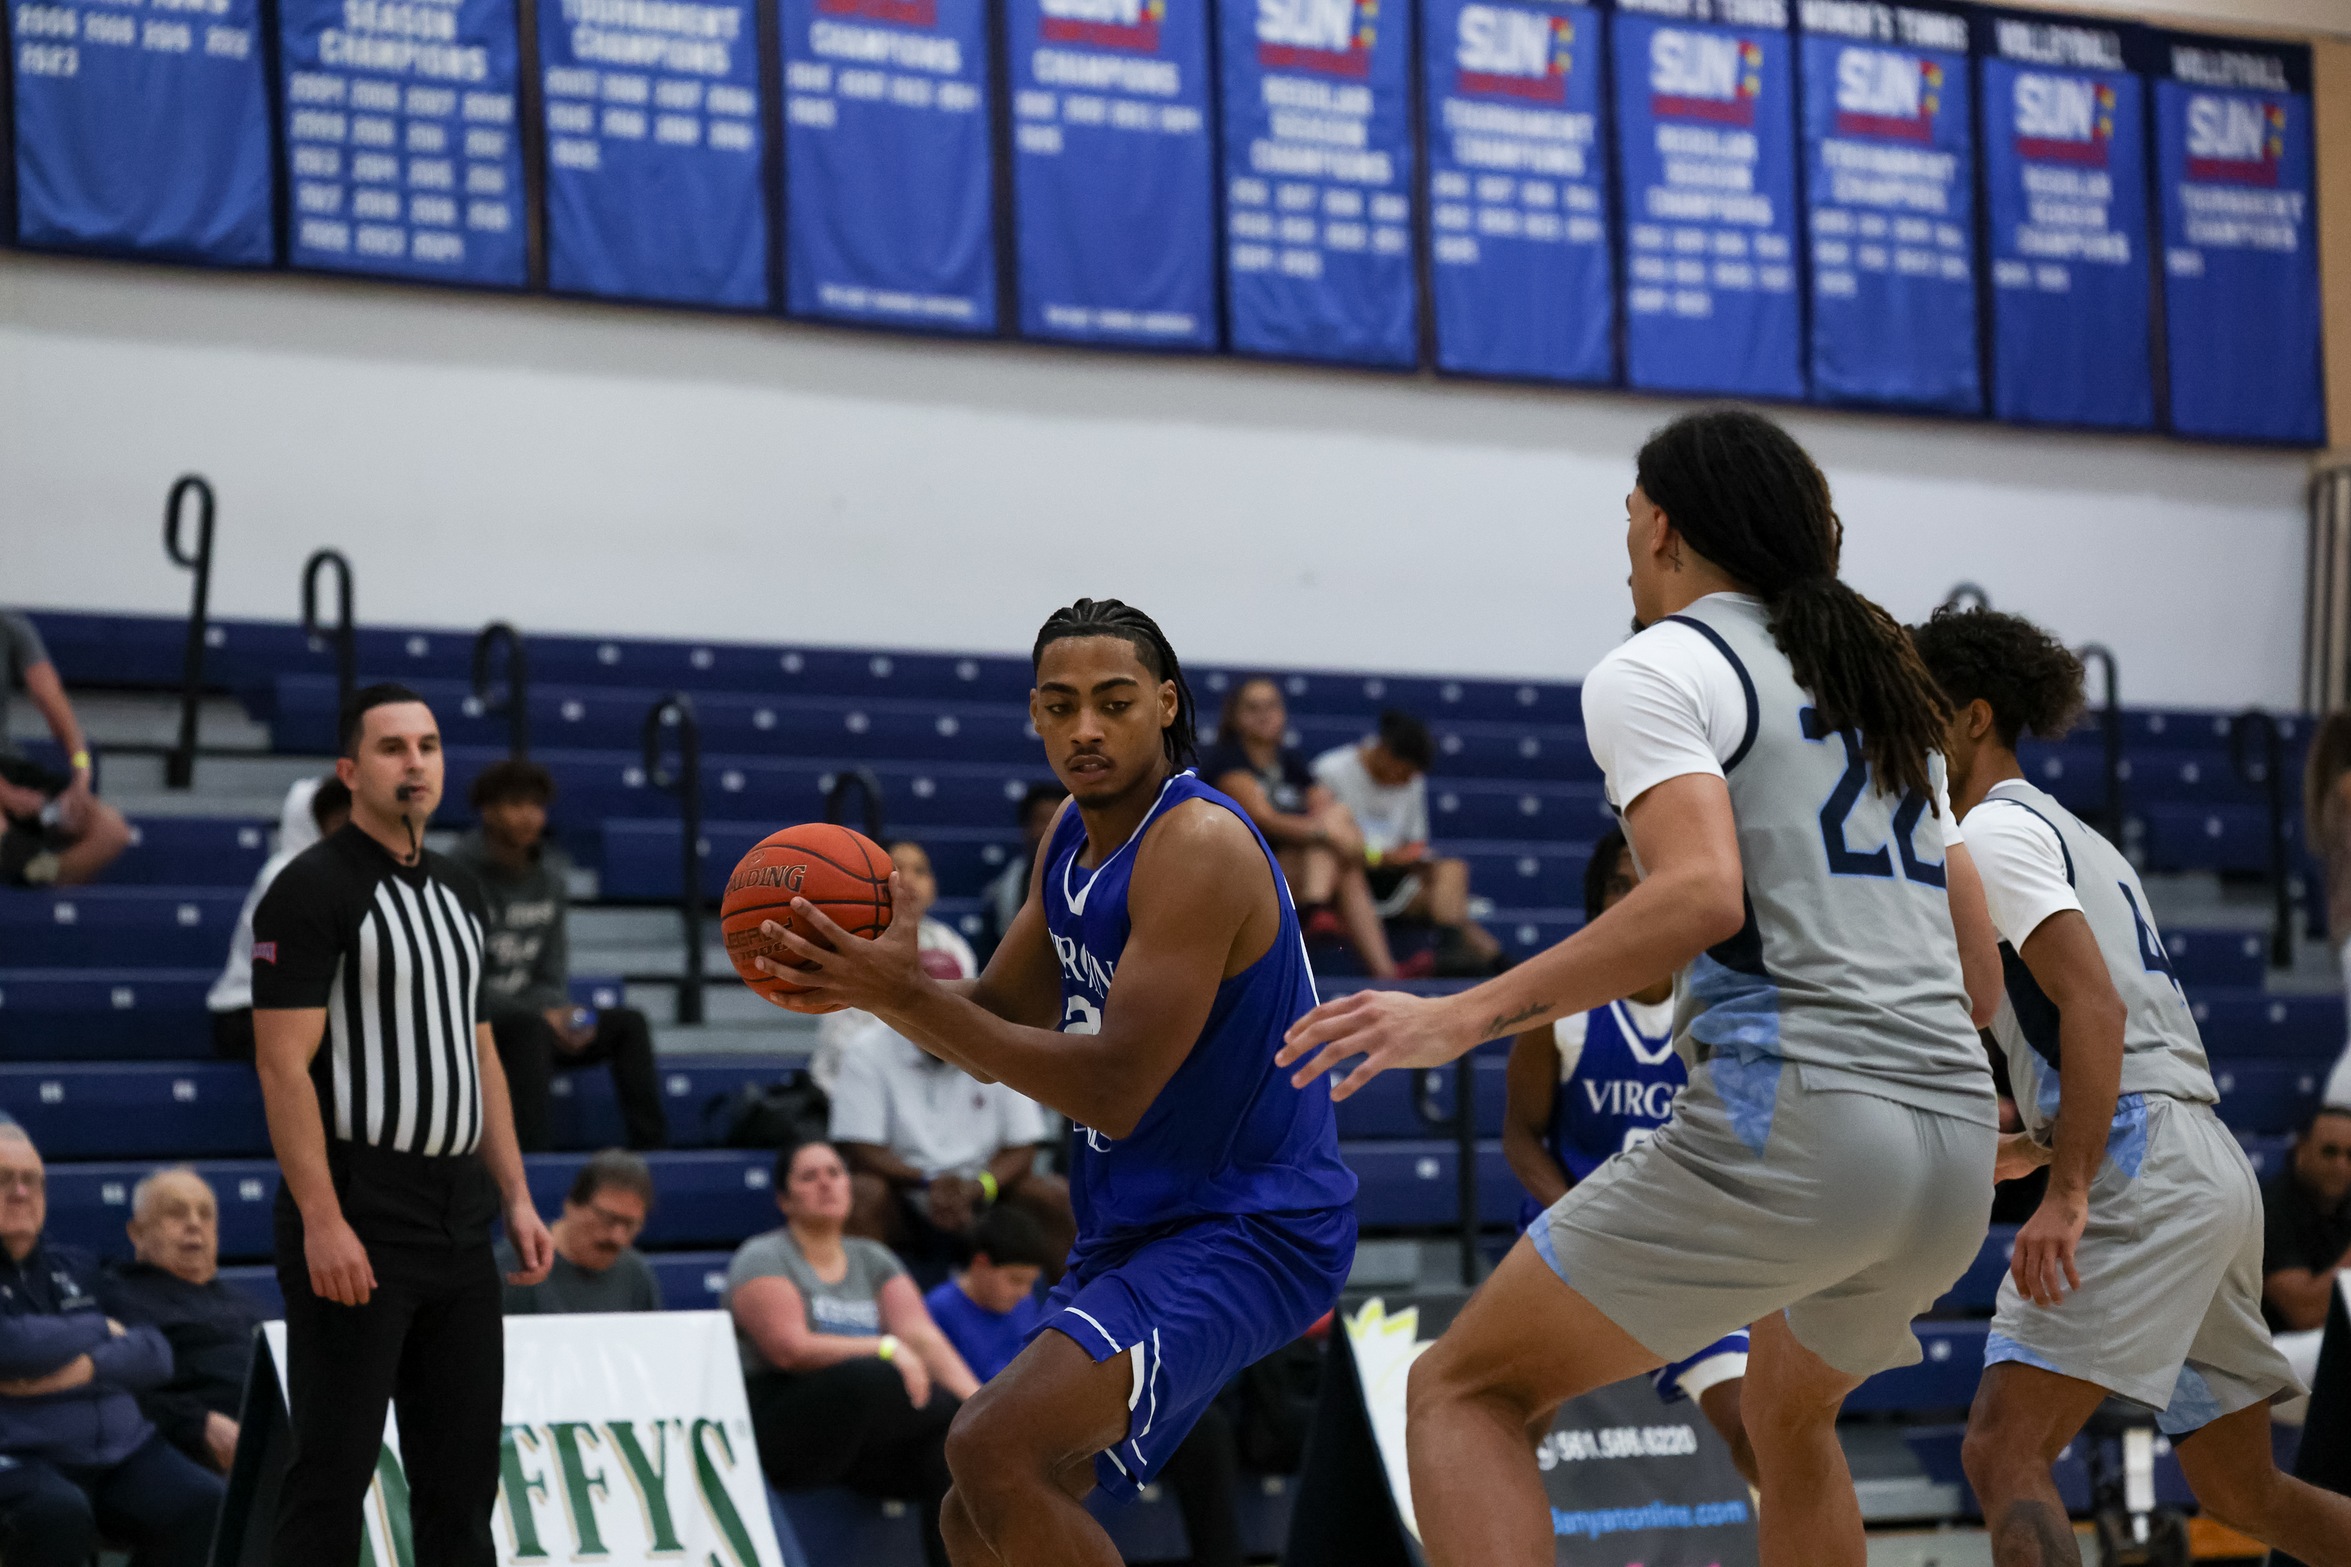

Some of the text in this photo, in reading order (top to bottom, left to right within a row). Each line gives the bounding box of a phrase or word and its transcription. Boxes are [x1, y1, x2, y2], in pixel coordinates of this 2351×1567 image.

[1456, 4, 1552, 79] SUN
[1650, 28, 1740, 100] SUN
[1836, 46, 1921, 117] SUN
[2014, 73, 2095, 141] SUN
[2186, 96, 2265, 161] SUN
[1798, 705, 1947, 889] 22
[727, 864, 807, 896] ALDING
[1582, 1078, 1688, 1120] VIRG
[499, 1417, 766, 1567] FFY'S
